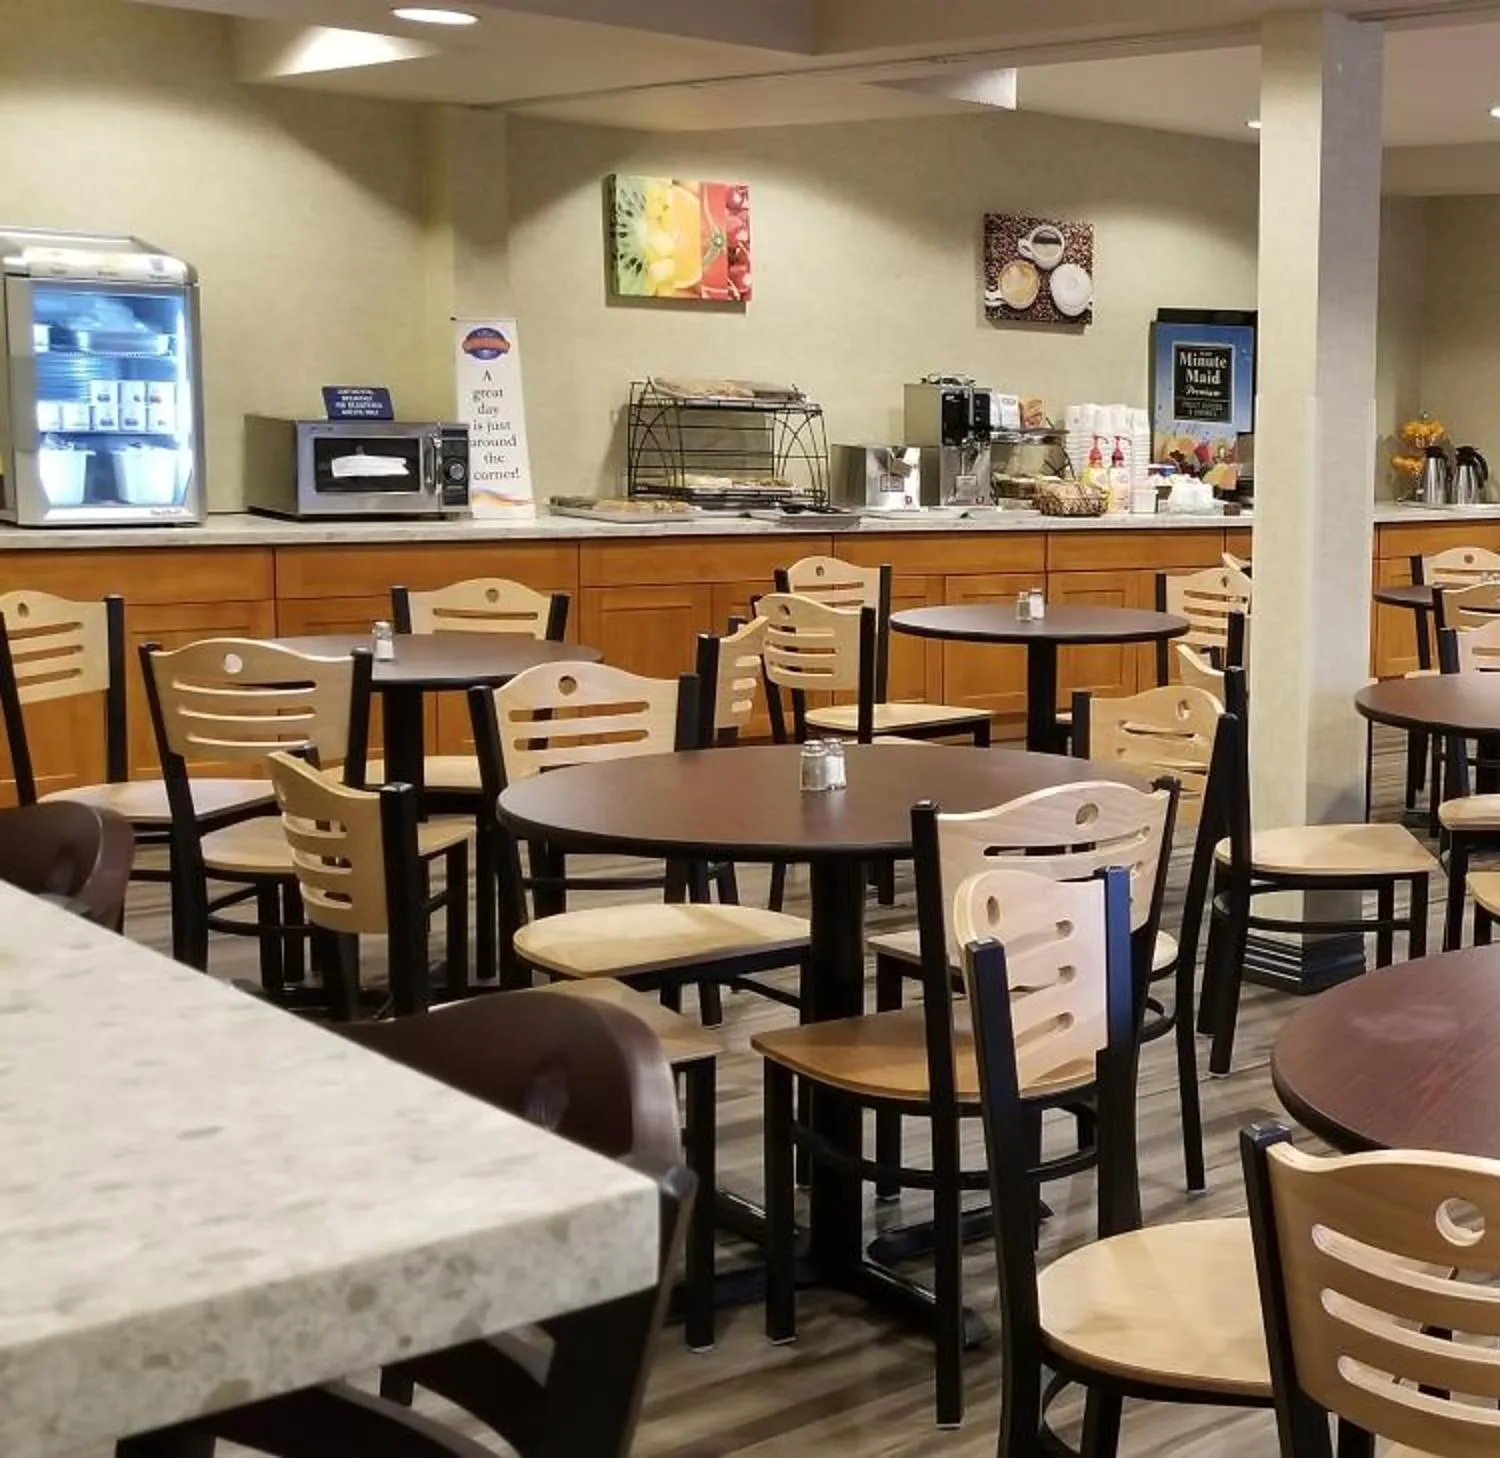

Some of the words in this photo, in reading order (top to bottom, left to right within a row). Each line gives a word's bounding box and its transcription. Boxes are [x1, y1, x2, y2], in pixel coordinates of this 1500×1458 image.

[1180, 352, 1227, 368] Minute
[483, 369, 492, 381] A
[1185, 369, 1222, 385] Maid
[472, 388, 503, 402] great
[477, 402, 498, 417] day
[473, 419, 483, 431] is
[487, 420, 511, 432] just
[469, 434, 517, 447] around
[484, 452, 505, 463] the
[473, 467, 520, 480] corner!
